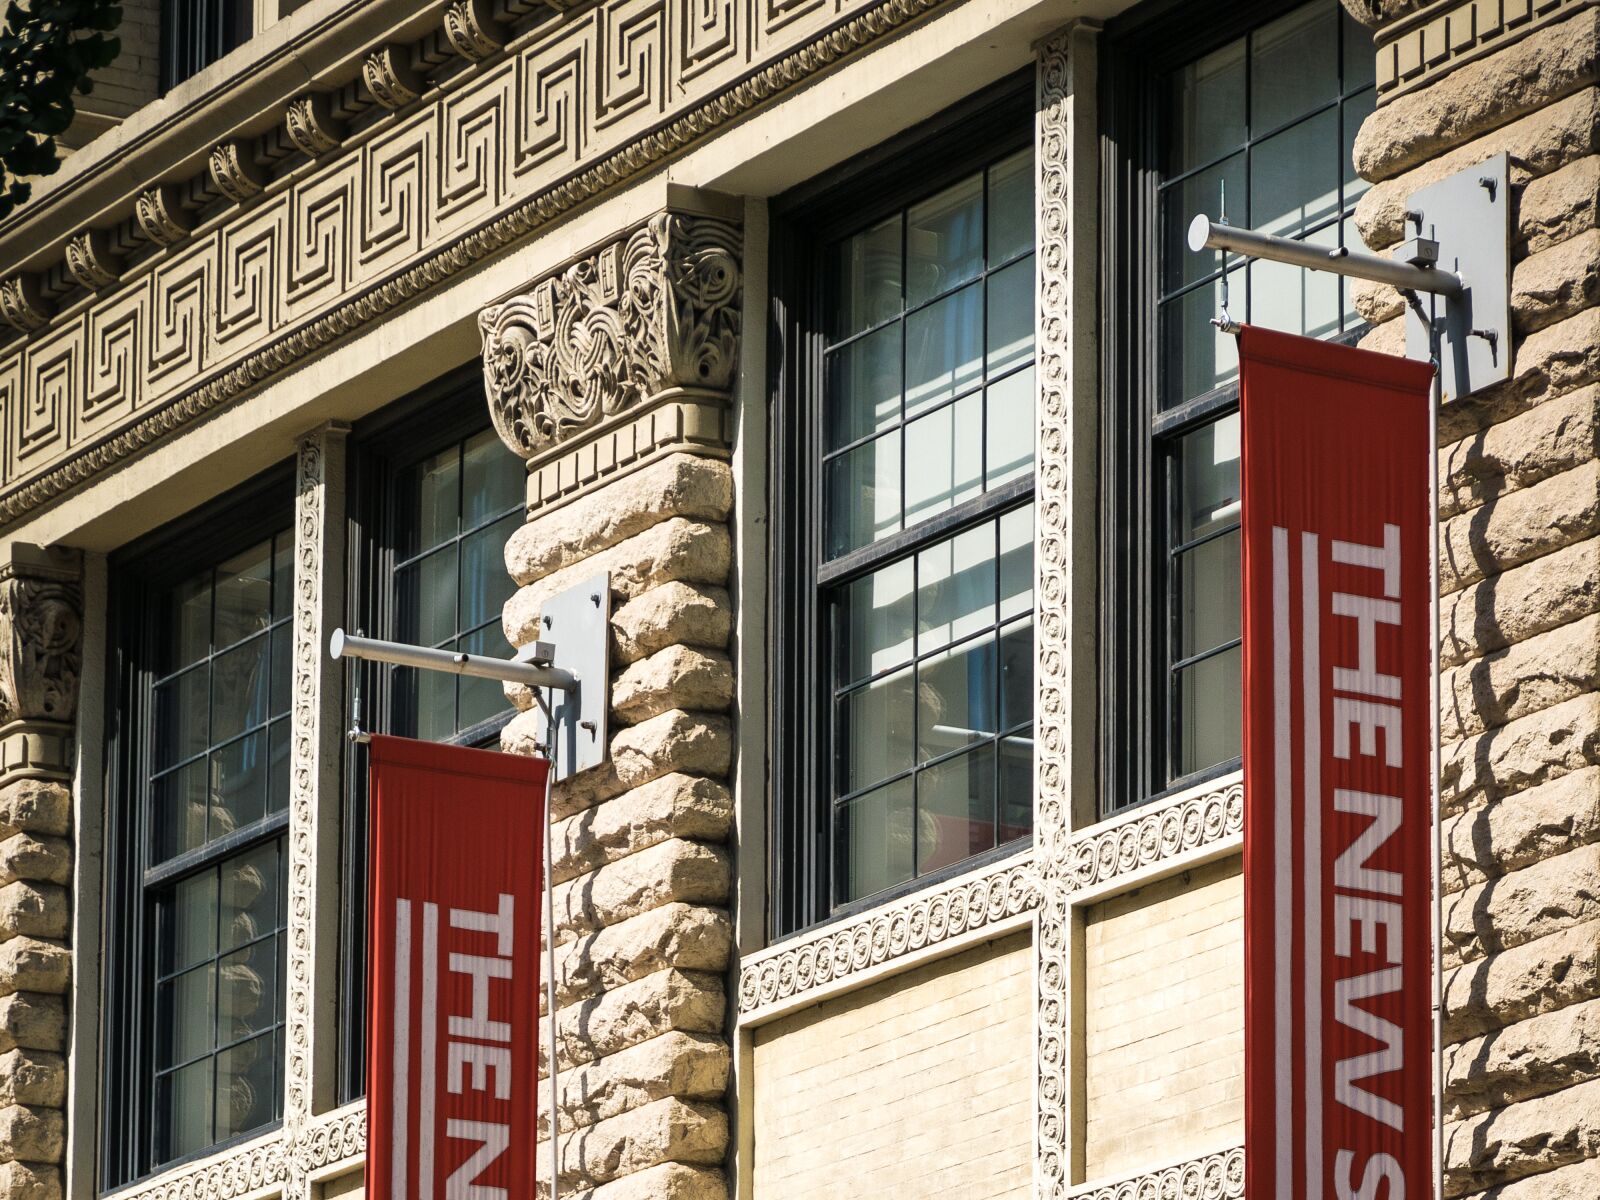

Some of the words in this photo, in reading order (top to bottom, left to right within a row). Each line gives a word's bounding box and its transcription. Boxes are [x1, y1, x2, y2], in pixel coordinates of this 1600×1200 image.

[1331, 523, 1403, 768] THE
[447, 893, 515, 1100] THE
[1334, 788, 1403, 1133] NEW
